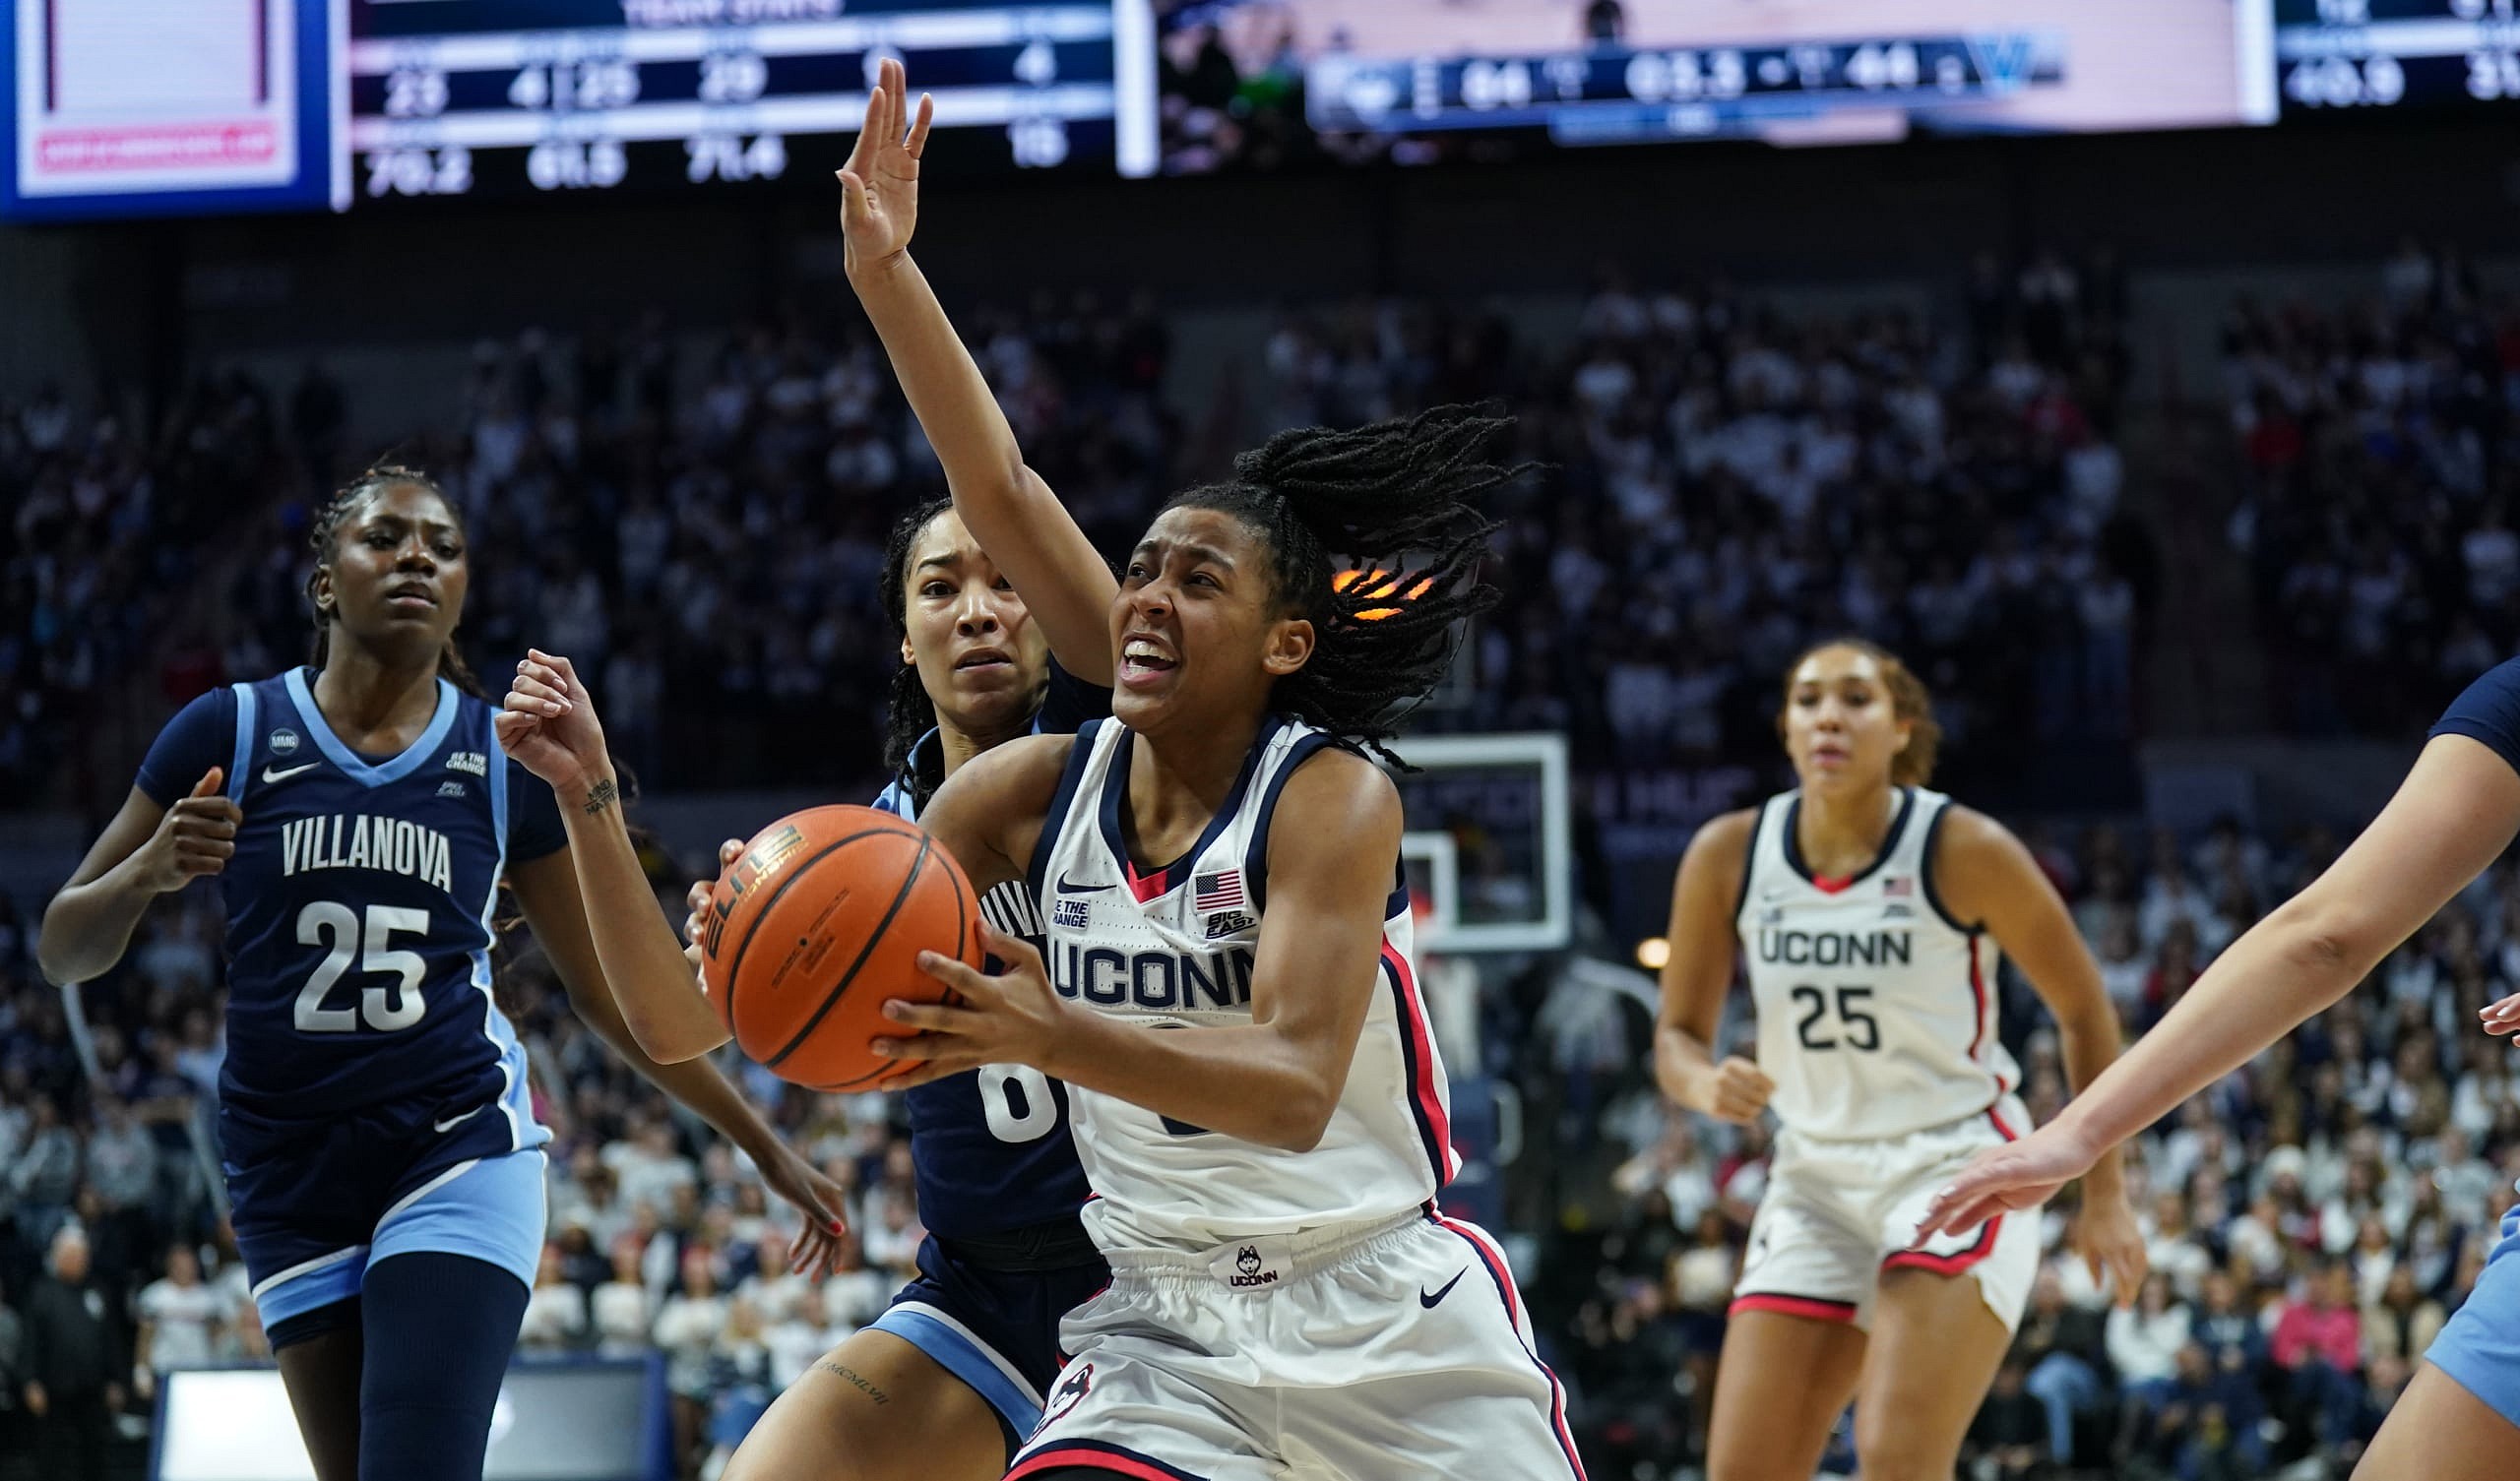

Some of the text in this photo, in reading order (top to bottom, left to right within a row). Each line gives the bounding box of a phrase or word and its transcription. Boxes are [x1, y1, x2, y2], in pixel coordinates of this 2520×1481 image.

[283, 814, 452, 894] VILLANOVA
[1064, 900, 1089, 915] THE
[1208, 910, 1242, 927] BIG
[1053, 912, 1089, 928] HANGE
[1205, 915, 1255, 938] EAST
[1760, 930, 1912, 966] UCONN
[293, 900, 431, 1032] 25
[1791, 986, 1881, 1052] 25
[1229, 1269, 1278, 1286] UCONN
